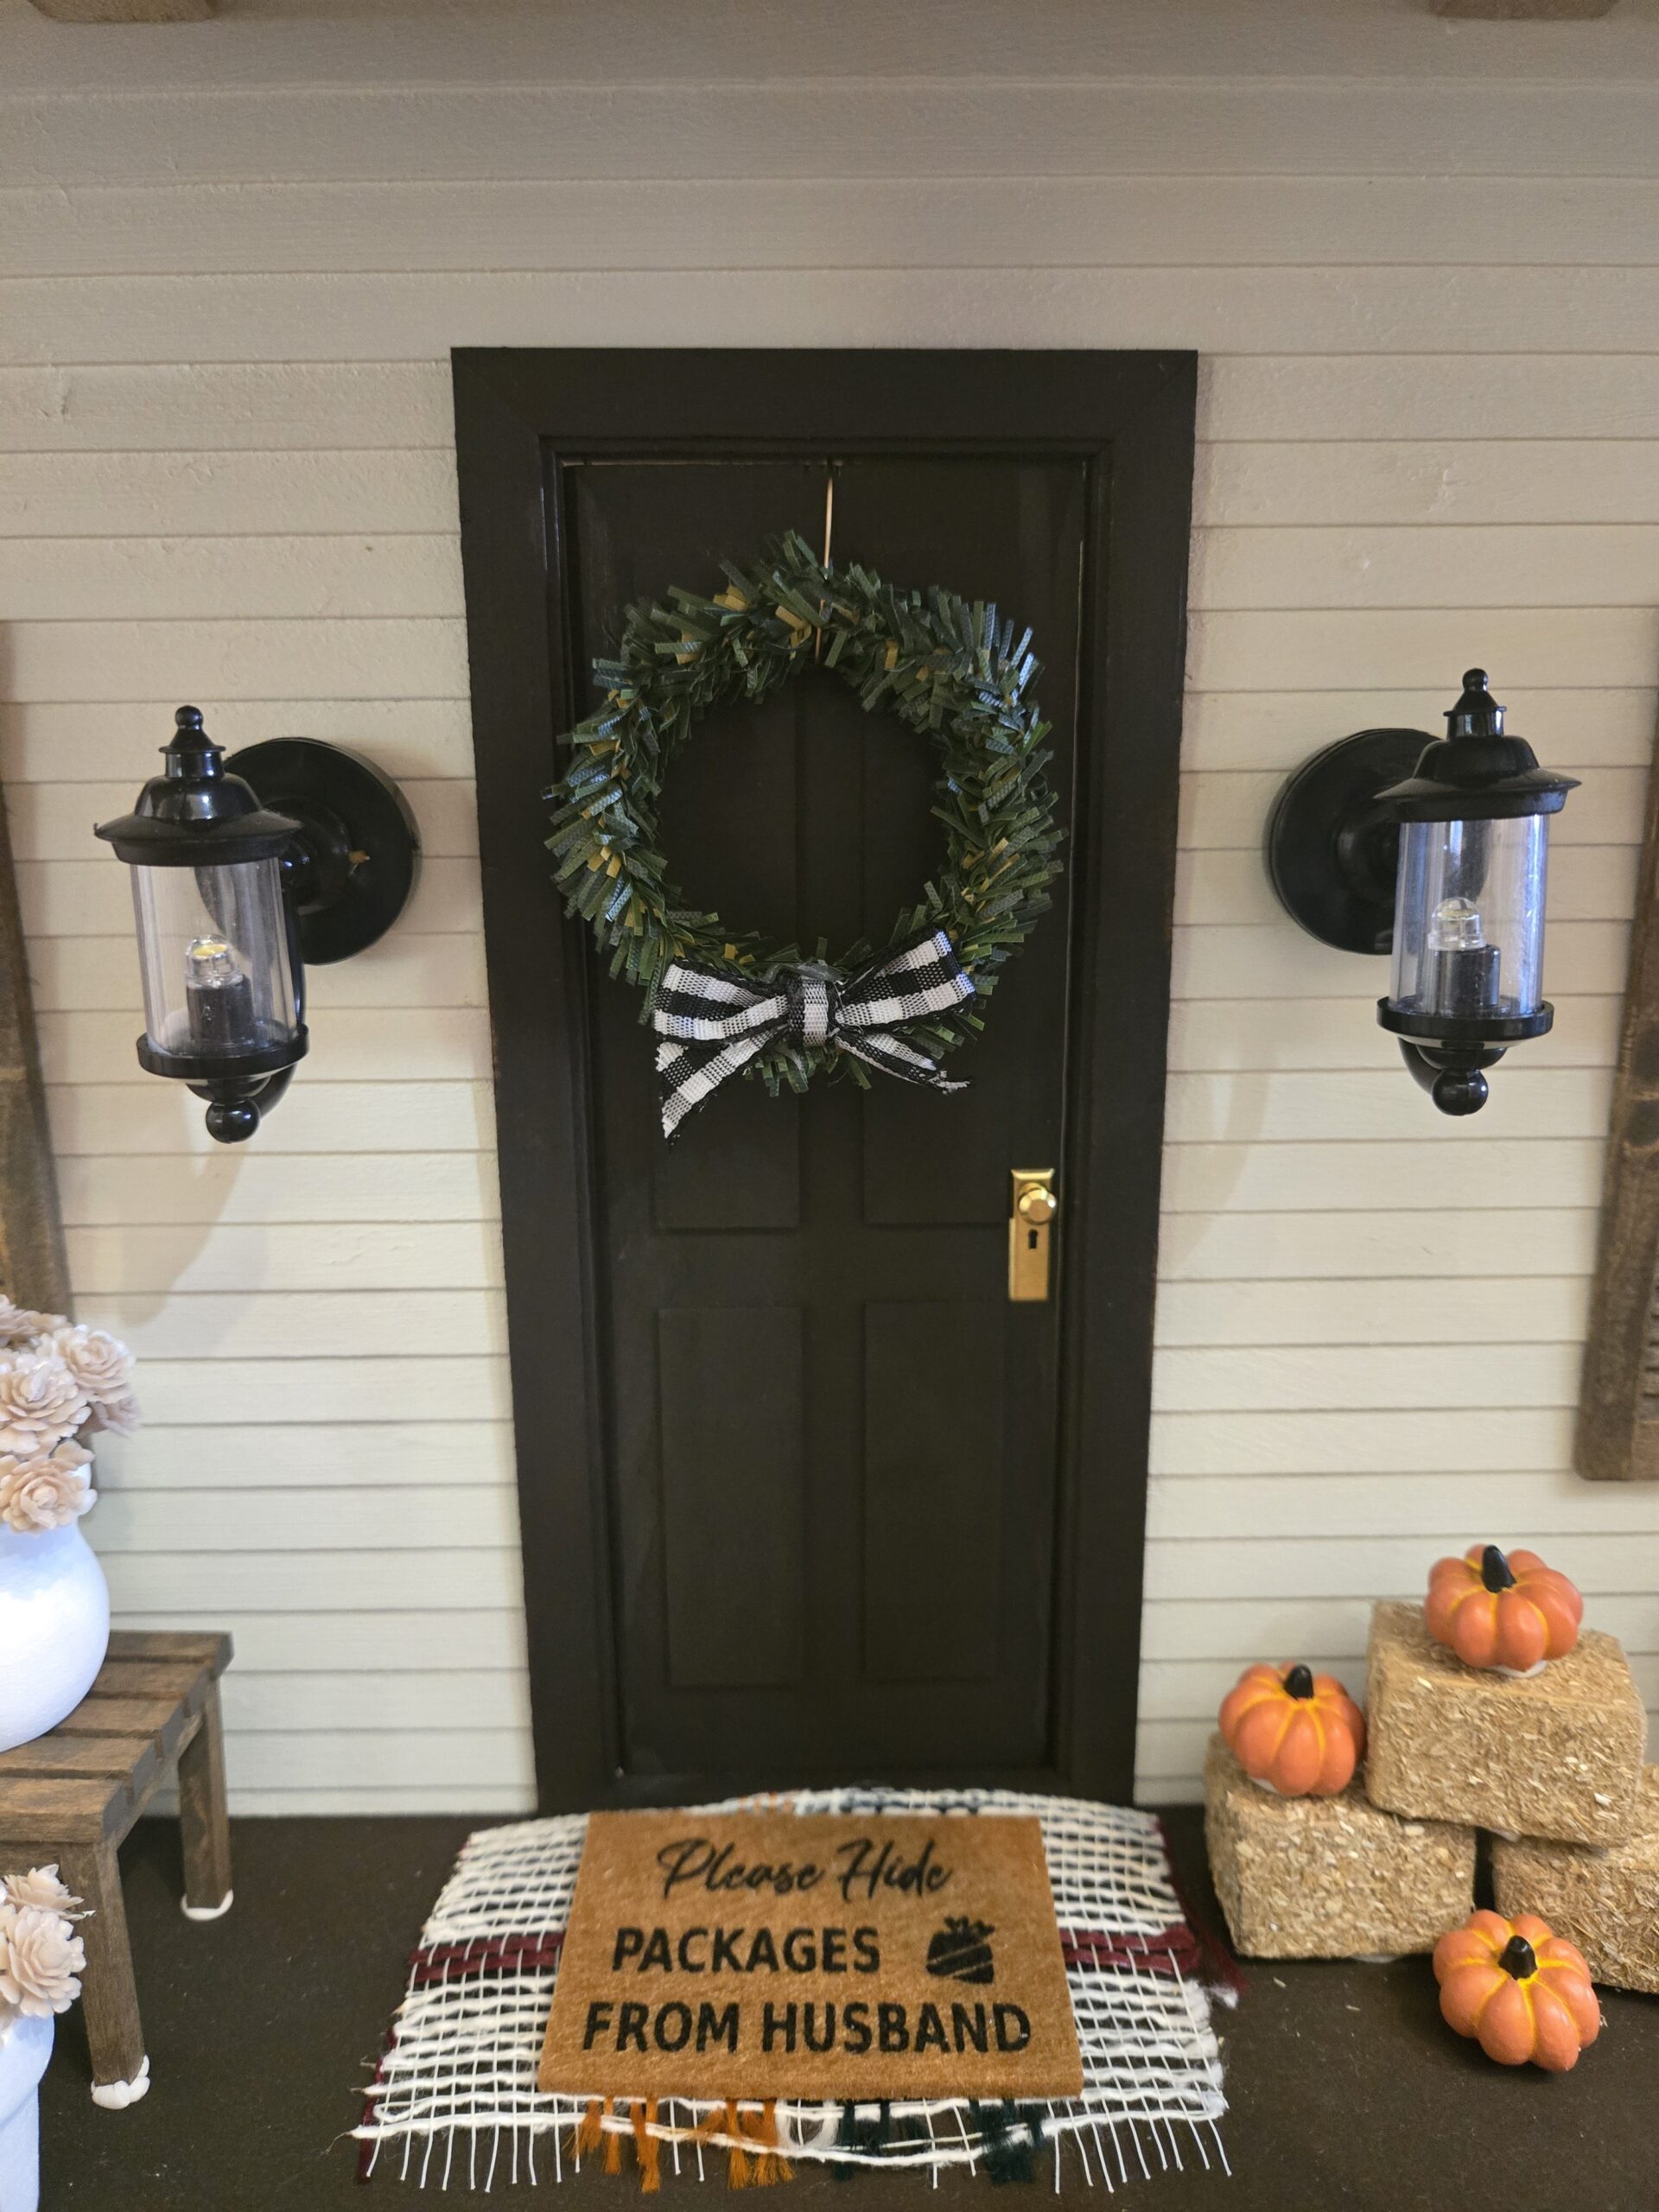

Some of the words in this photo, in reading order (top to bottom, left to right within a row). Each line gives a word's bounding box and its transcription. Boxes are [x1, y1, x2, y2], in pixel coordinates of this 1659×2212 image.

[657, 1837, 826, 1900] Please
[836, 1836, 954, 1904] Hide
[612, 1927, 880, 1974] PACKAGES
[582, 2000, 741, 2054] FROM
[761, 2001, 1032, 2055] HUSBAND
